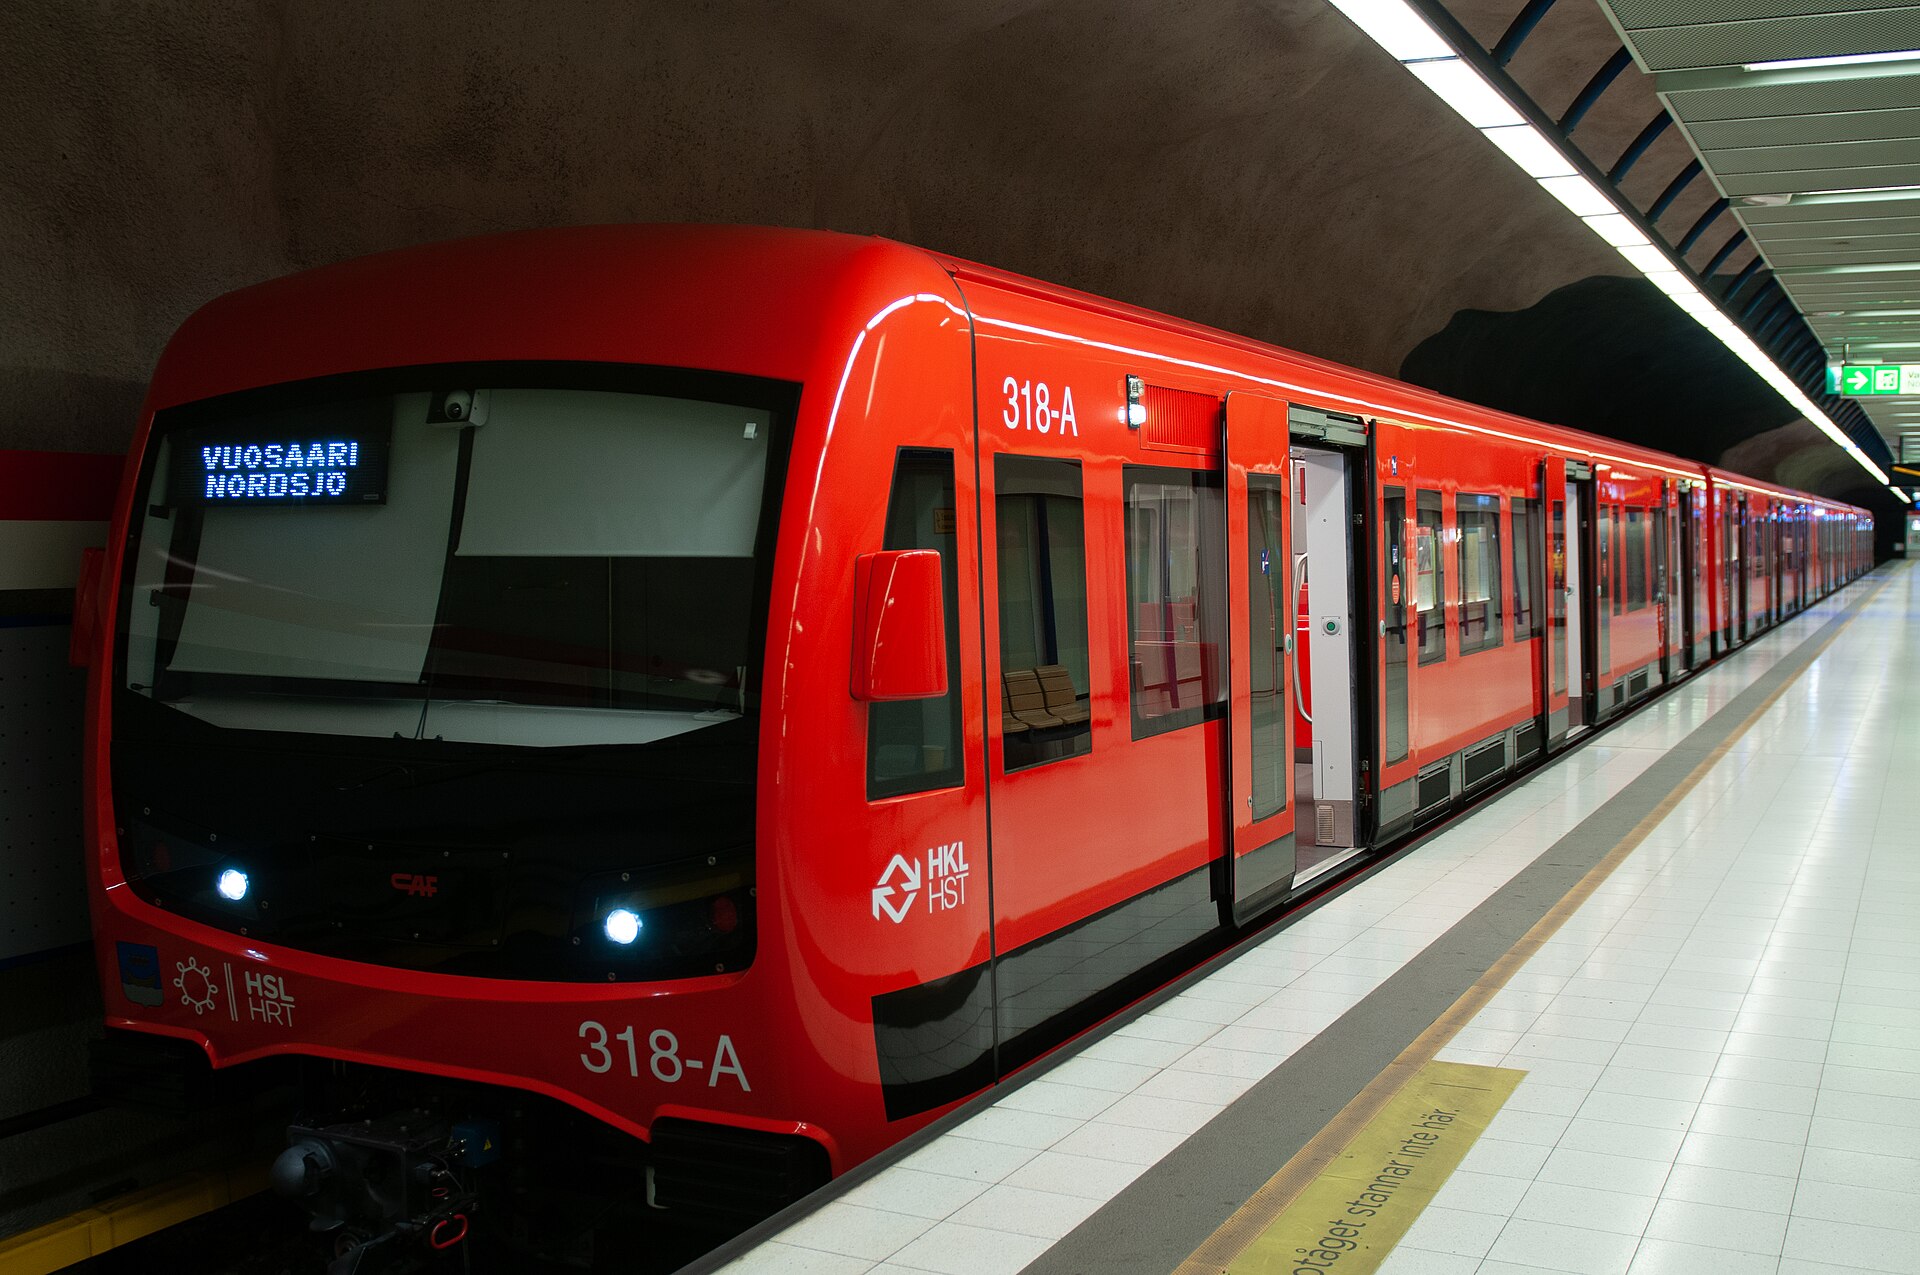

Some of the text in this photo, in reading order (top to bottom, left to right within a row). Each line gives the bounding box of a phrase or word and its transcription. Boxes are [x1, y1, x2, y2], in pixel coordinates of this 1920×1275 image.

[1003, 376, 1078, 437] 318-A
[203, 442, 357, 469] VUOSAARI
[206, 472, 346, 498] NORDSJÖ
[928, 841, 969, 880] HKL
[391, 873, 438, 897] CAF
[928, 872, 969, 914] HST
[245, 971, 294, 1002] HSL
[249, 997, 295, 1027] HRT
[579, 1021, 751, 1092] 318-A
[1411, 1108, 1460, 1130] här.
[1388, 1132, 1439, 1158] inte
[1345, 1160, 1415, 1217] stannar
